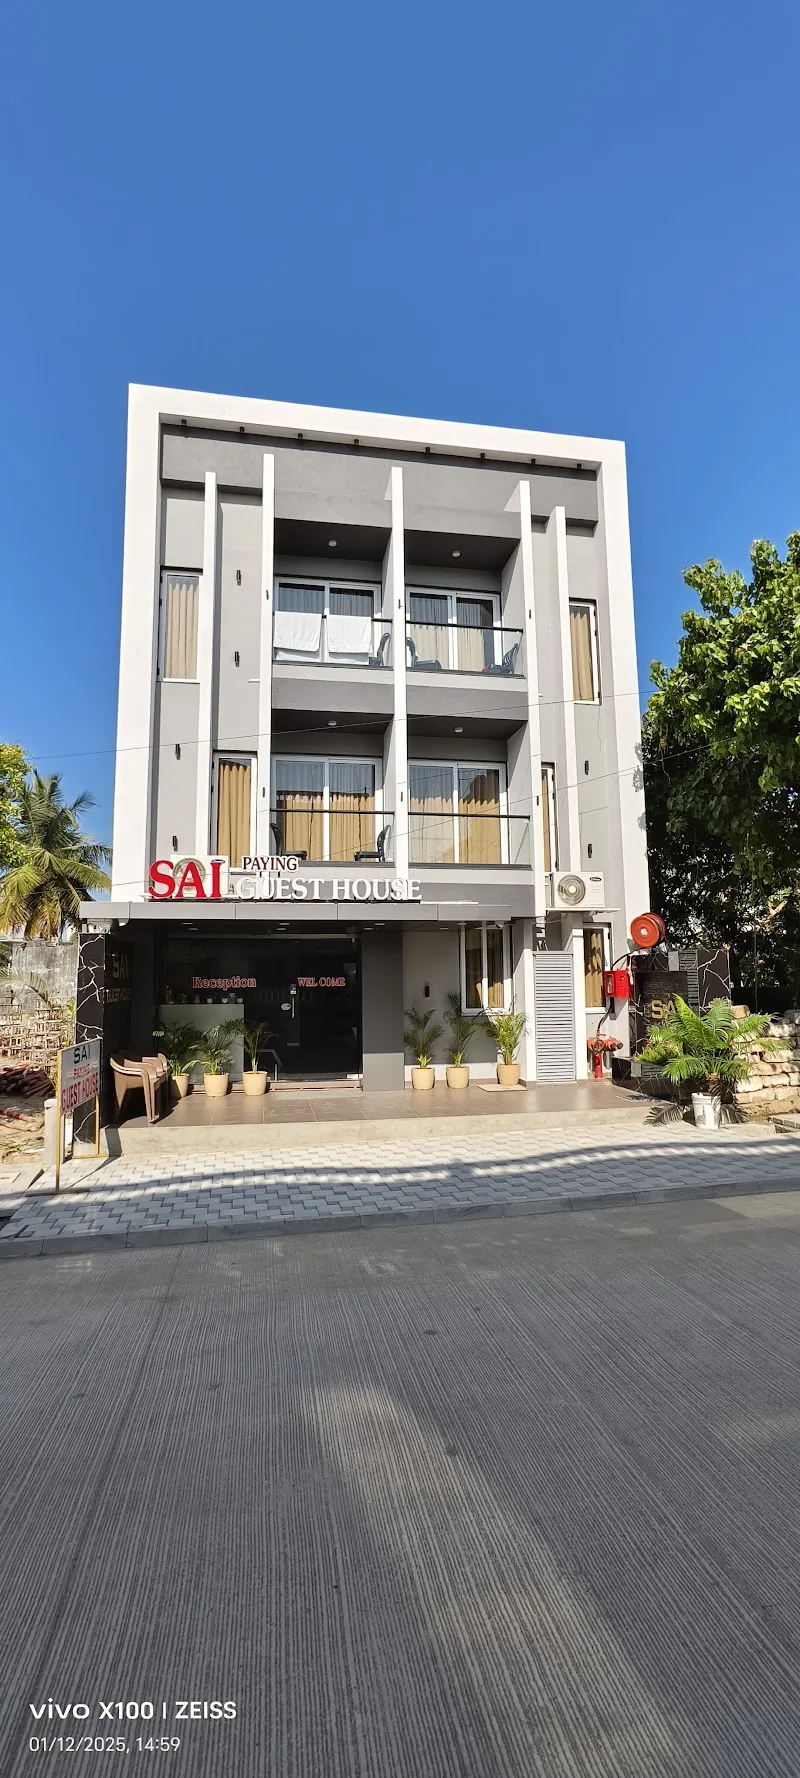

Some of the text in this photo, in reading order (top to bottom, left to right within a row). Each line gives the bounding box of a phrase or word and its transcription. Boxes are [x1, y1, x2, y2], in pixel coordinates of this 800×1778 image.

[242, 855, 298, 872] PAYING
[148, 859, 222, 898] SAI
[236, 877, 422, 901] GUEST HOUSE
[192, 975, 257, 991] Reception
[651, 1000, 677, 1019] SA
[73, 1044, 91, 1065] SAI
[61, 1072, 99, 1112] GUEST HOUSE
